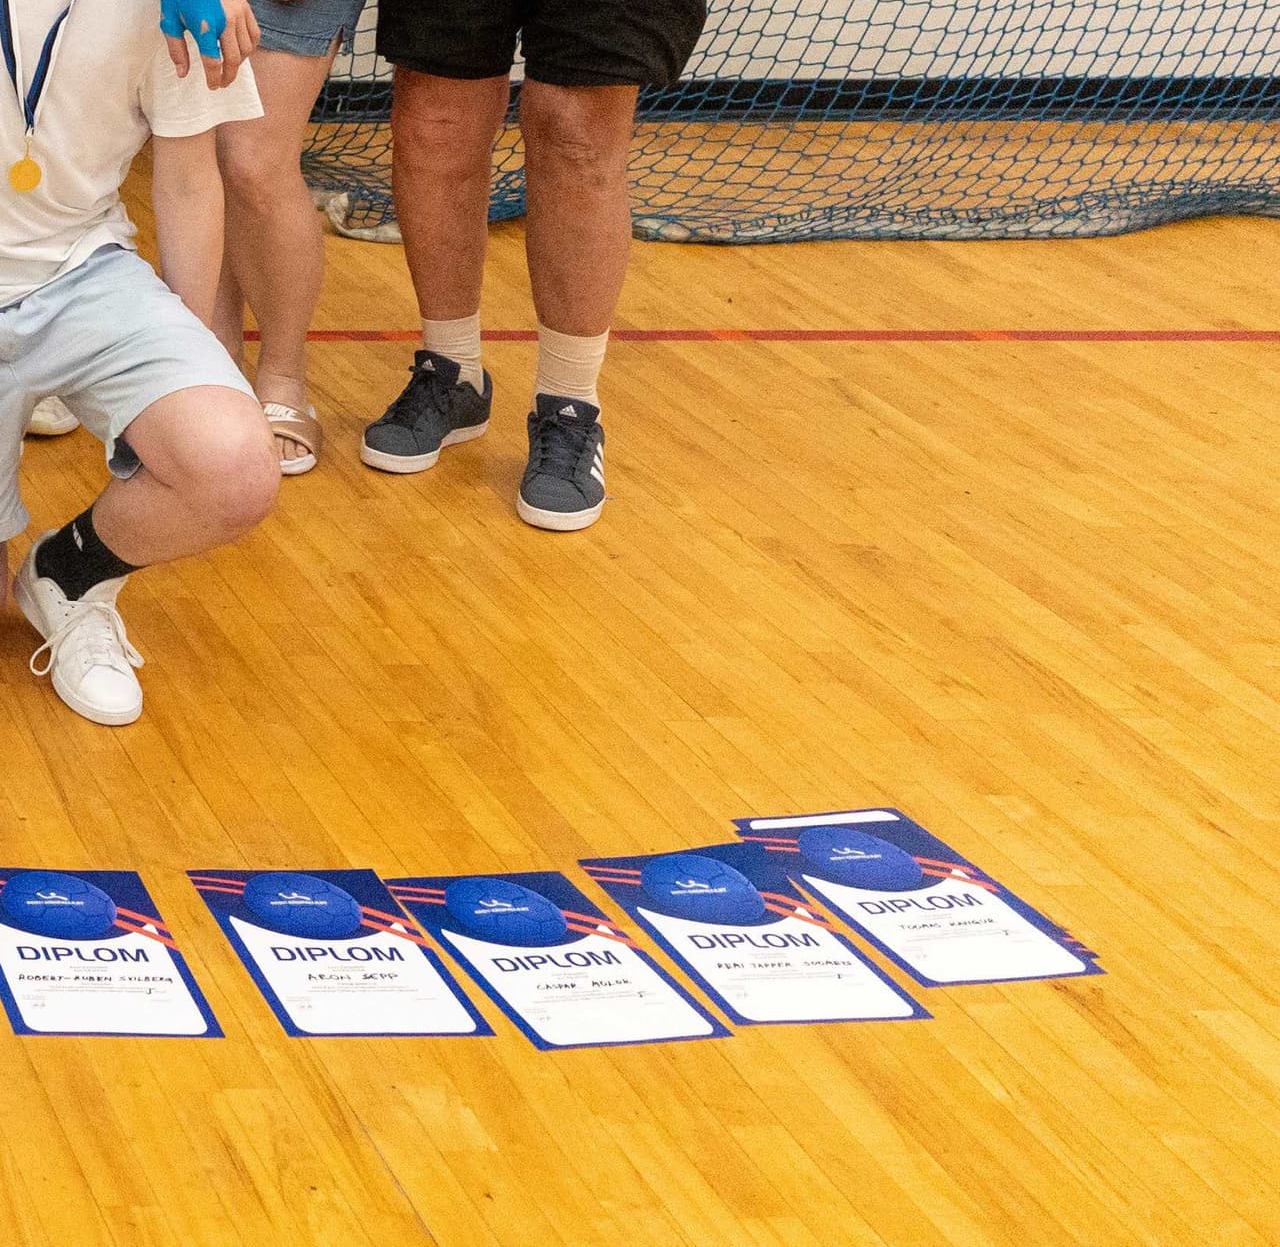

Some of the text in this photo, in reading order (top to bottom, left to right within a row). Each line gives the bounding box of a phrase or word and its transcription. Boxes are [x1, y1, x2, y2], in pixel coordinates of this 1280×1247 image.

[857, 893, 984, 915] DIPLOM
[687, 932, 820, 950] DIPLOM
[15, 945, 150, 963] DIPLOM
[270, 946, 405, 962] DIPLOM
[490, 949, 622, 973] DIPLOM
